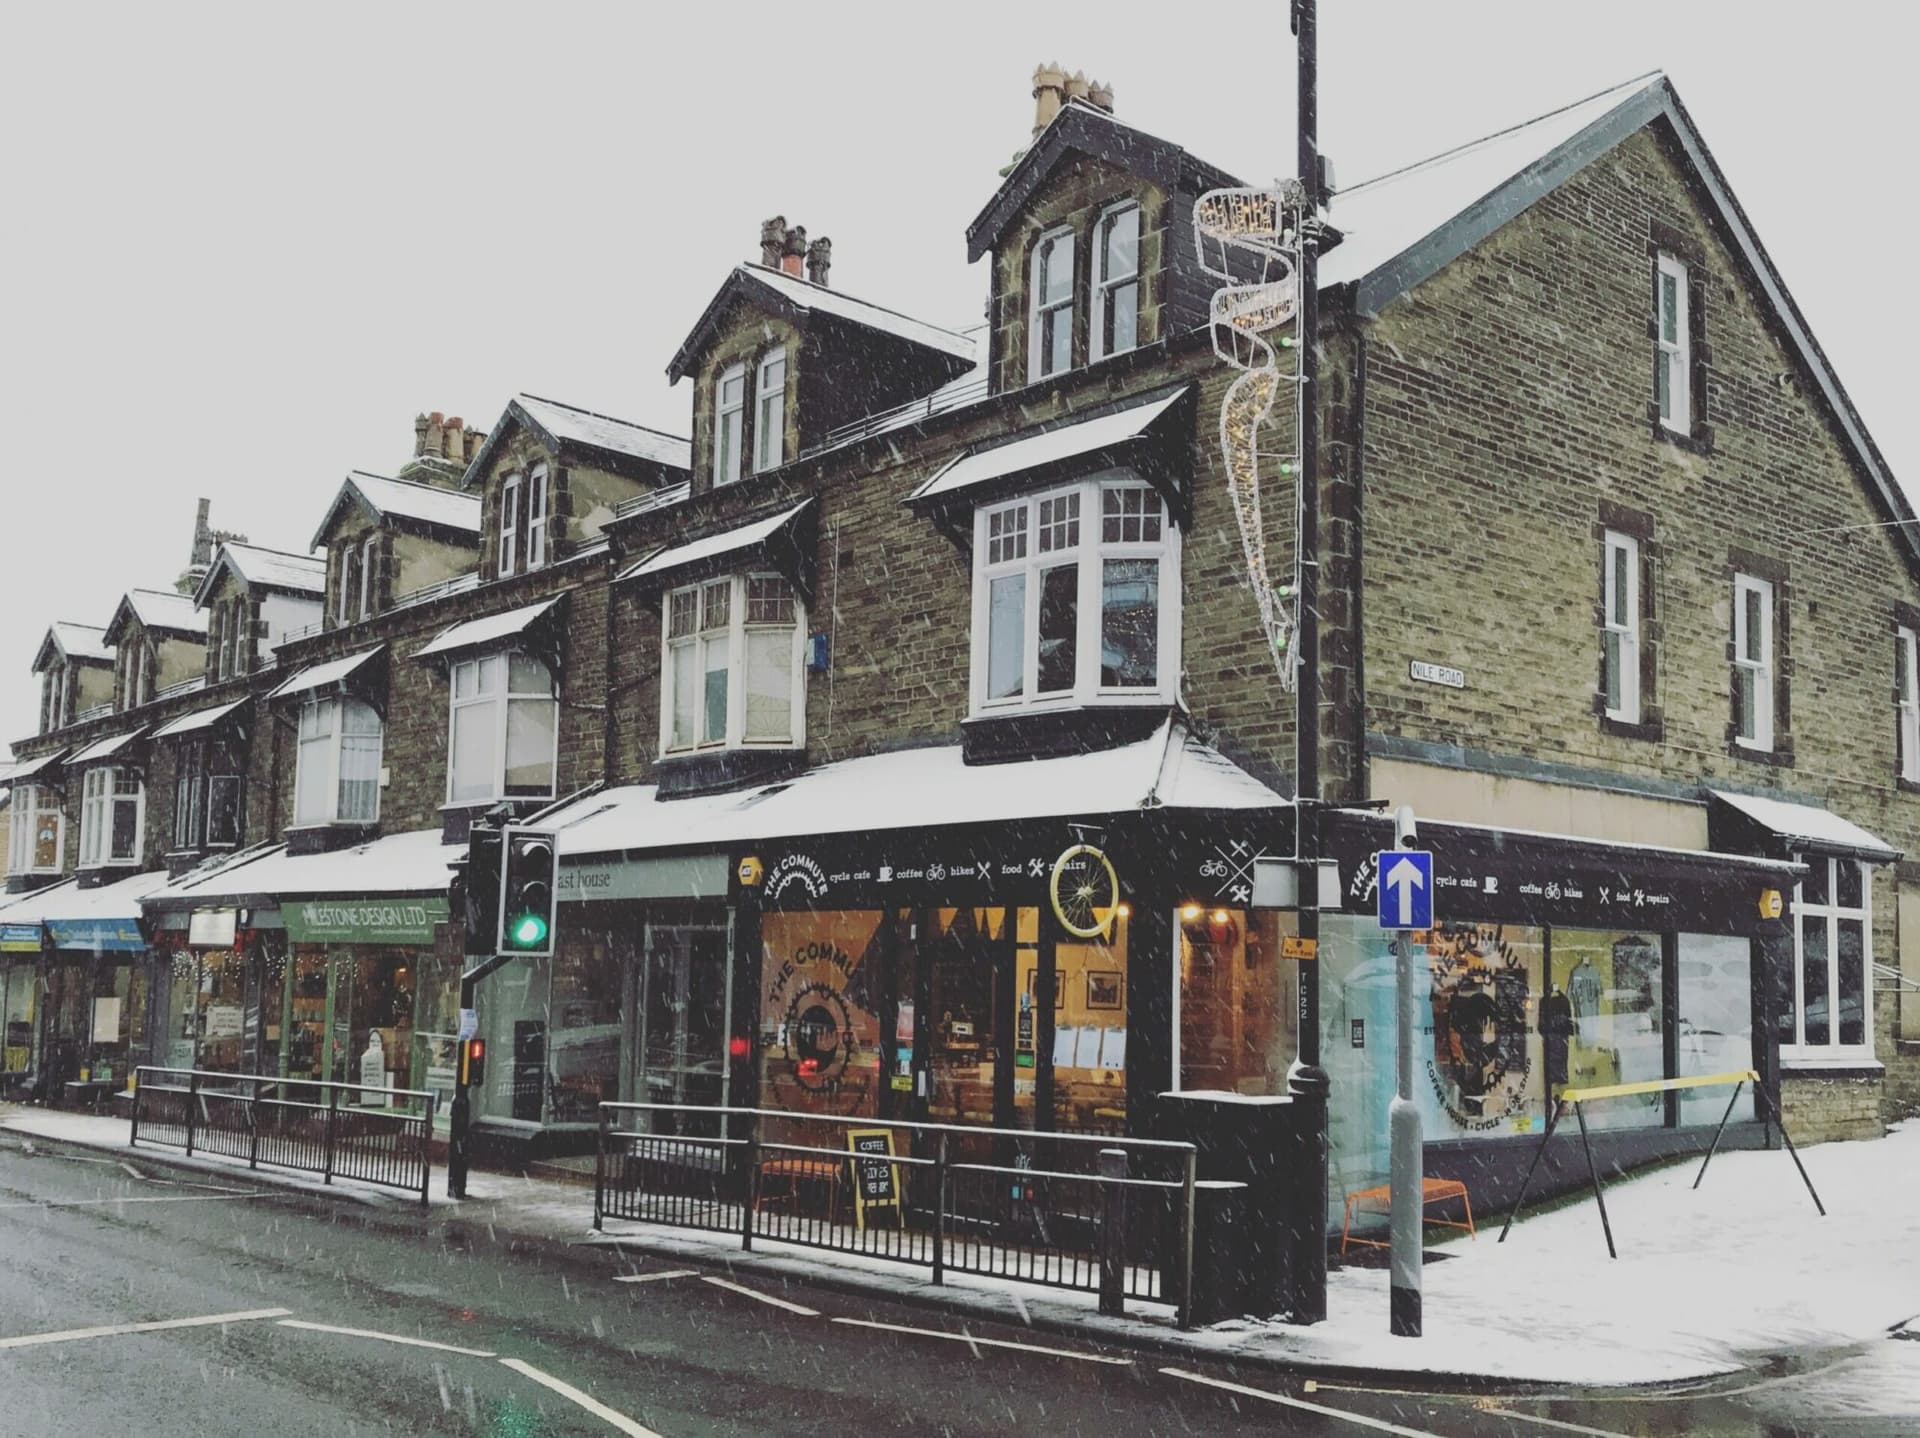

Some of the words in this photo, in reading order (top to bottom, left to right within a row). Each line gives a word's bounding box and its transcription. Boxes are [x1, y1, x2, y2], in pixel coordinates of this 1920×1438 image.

[1413, 663, 1433, 680] NILE
[1439, 668, 1462, 685] ROAD
[558, 872, 574, 889] ast
[578, 870, 610, 888] house
[764, 867, 782, 896] THE
[781, 854, 828, 895] COMMUTE
[830, 872, 850, 883] cycle
[854, 870, 871, 880] cafe
[897, 869, 923, 879] coffee
[950, 866, 975, 876] bikes
[1001, 864, 1022, 874] food
[1049, 860, 1086, 872] rairs
[1350, 860, 1371, 897] THE
[1436, 875, 1457, 888] cycle
[1460, 877, 1478, 888] cafe
[1519, 883, 1543, 895] coffee
[1564, 887, 1583, 899] bikes
[1616, 891, 1631, 902] food
[1646, 894, 1670, 905] repairs
[360, 906, 402, 926] DESIGN
[402, 905, 426, 926] LTD
[1475, 1116, 1500, 1131] CYCLE
